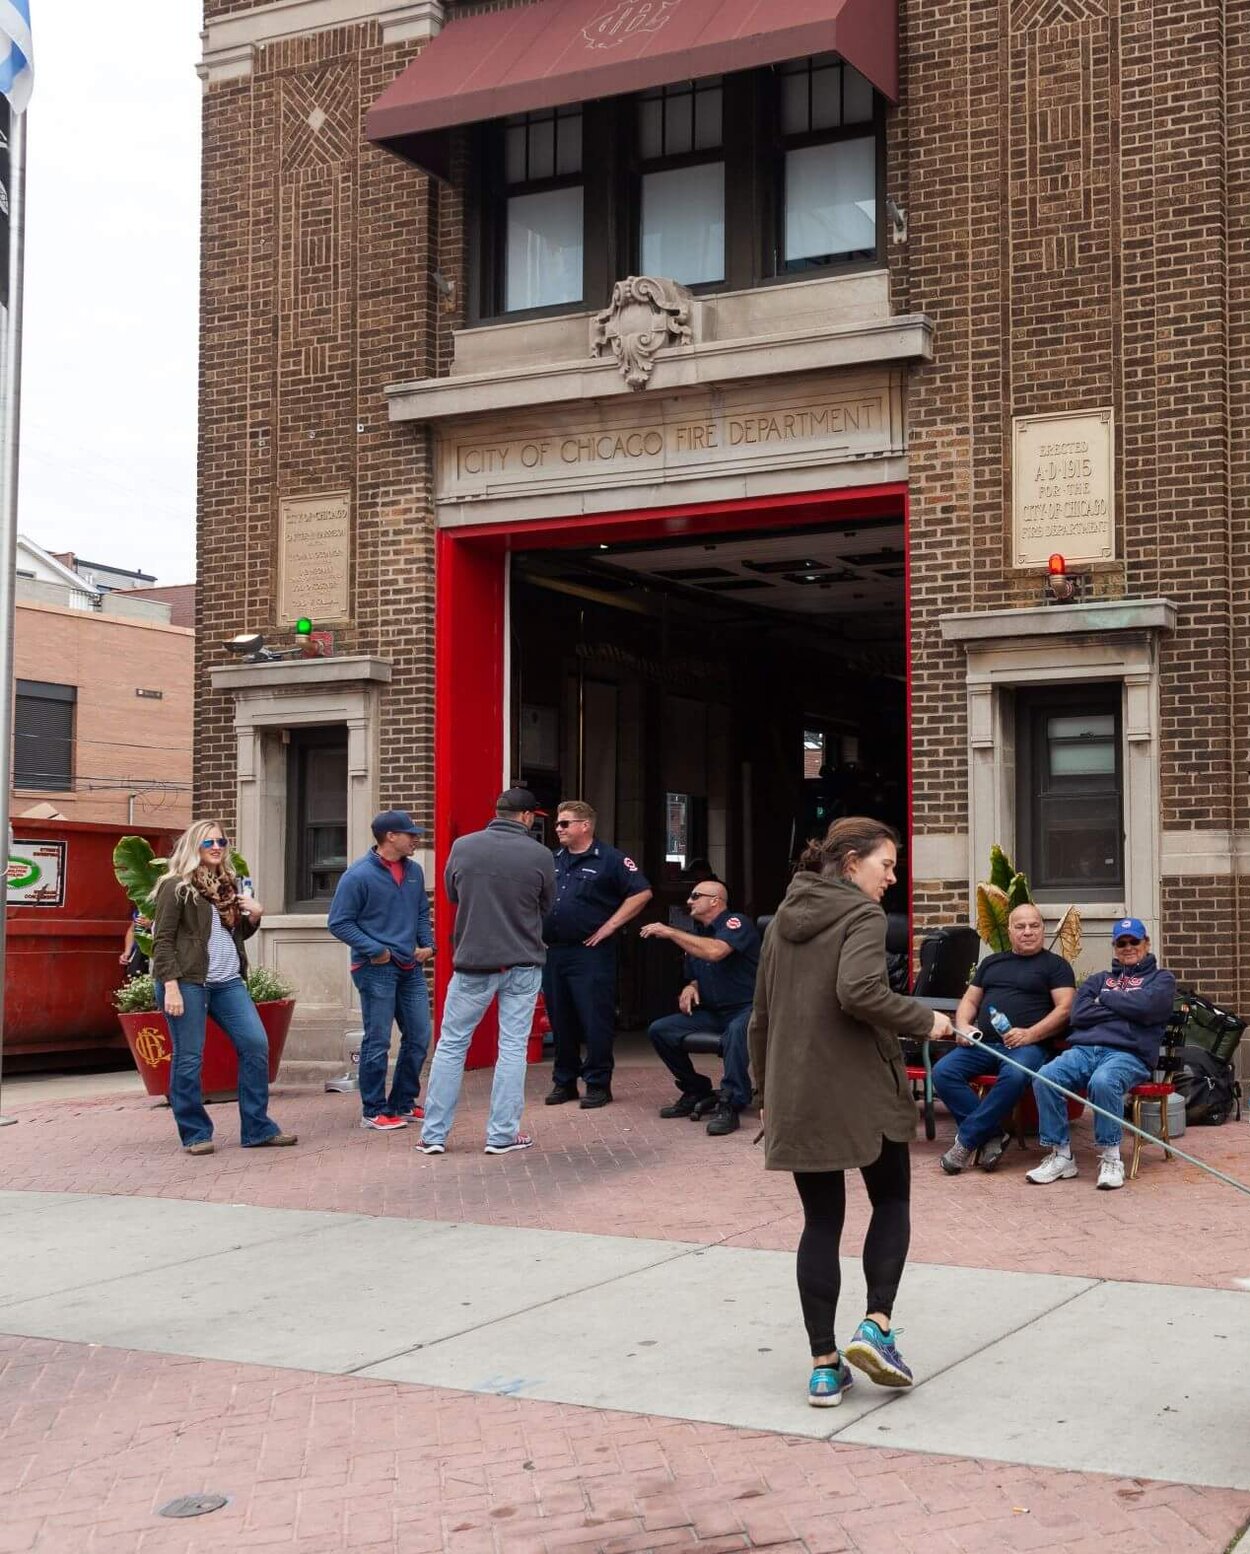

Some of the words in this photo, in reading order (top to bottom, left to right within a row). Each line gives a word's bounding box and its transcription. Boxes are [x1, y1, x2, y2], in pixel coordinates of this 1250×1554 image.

[464, 446, 509, 475] CITY
[520, 442, 549, 468] OF
[561, 431, 663, 464] CHICAGO
[676, 424, 717, 453] FIRE
[730, 404, 876, 446] DEPARTMENT
[1039, 441, 1089, 457] ERECTED
[1064, 499, 1107, 519] CHICAGO
